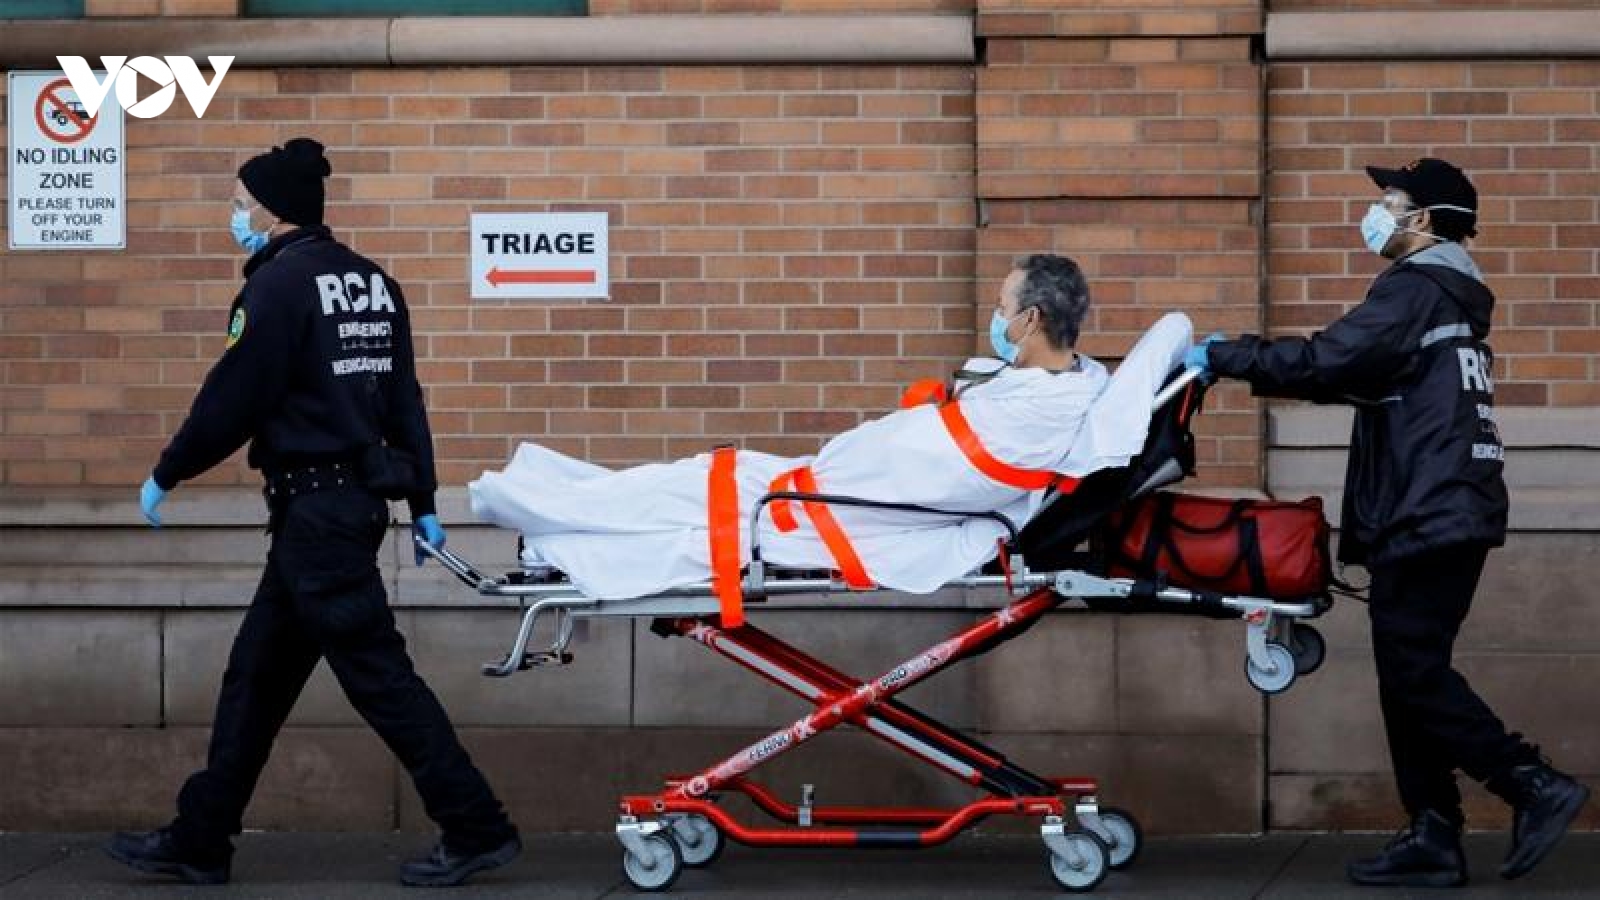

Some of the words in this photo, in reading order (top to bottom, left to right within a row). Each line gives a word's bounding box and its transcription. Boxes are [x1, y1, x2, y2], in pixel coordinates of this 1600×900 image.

[16, 148, 45, 165] NO
[51, 148, 117, 165] IDLING
[39, 172, 95, 189] ZONE
[18, 197, 73, 211] PLEASE
[79, 197, 116, 210] TURN
[31, 213, 59, 226] OFF
[64, 213, 103, 226] YOUR
[41, 229, 94, 243] ENGINE
[480, 232, 596, 255] TRIAGE
[315, 271, 397, 316] RCA
